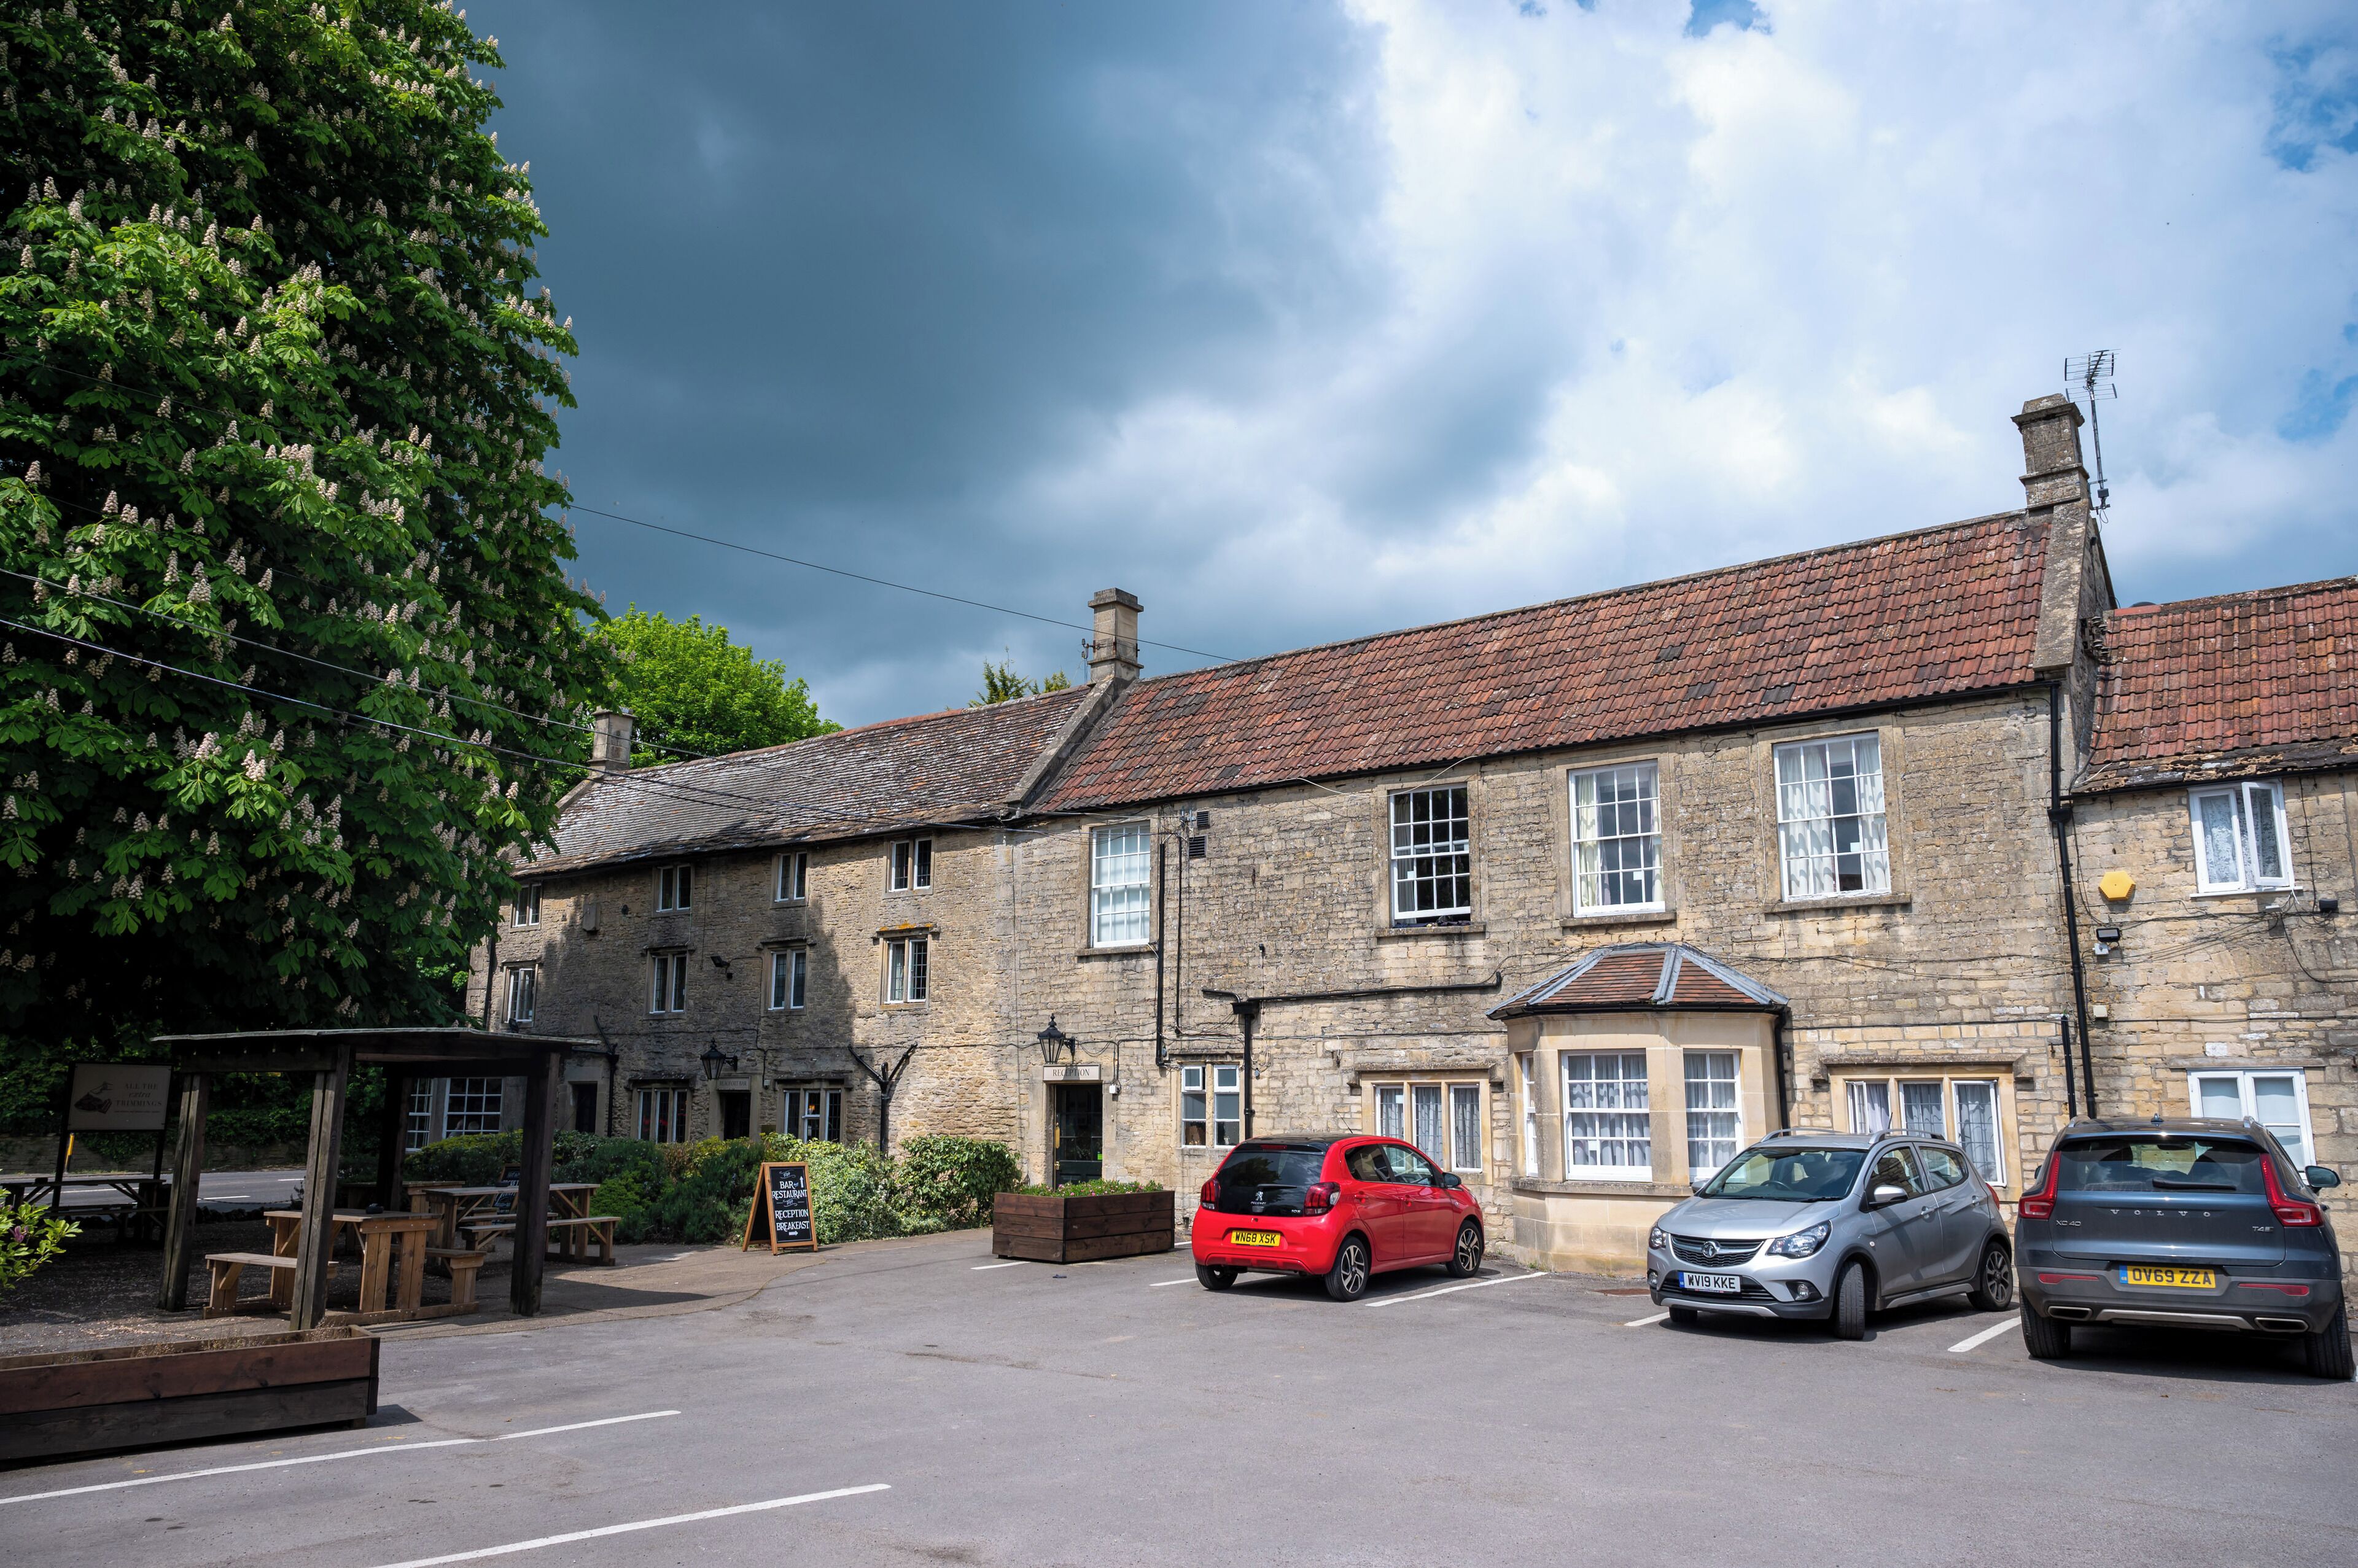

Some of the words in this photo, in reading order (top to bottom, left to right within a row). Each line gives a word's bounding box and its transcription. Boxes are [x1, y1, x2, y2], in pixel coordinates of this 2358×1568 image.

[779, 1181, 795, 1189] BAR
[772, 1189, 807, 1200] RESTAURANT
[775, 1209, 809, 1220] RECEPTION
[2110, 1209, 2211, 1217] VOLVO
[776, 1221, 810, 1232] BREAKFAST
[1235, 1232, 1257, 1243] WN68
[1259, 1233, 1276, 1244] XSK
[1687, 1274, 1711, 1287] WV19
[1713, 1276, 1736, 1289] KKE
[2132, 1268, 2174, 1283] OV69
[2179, 1270, 2212, 1285] ZZA
